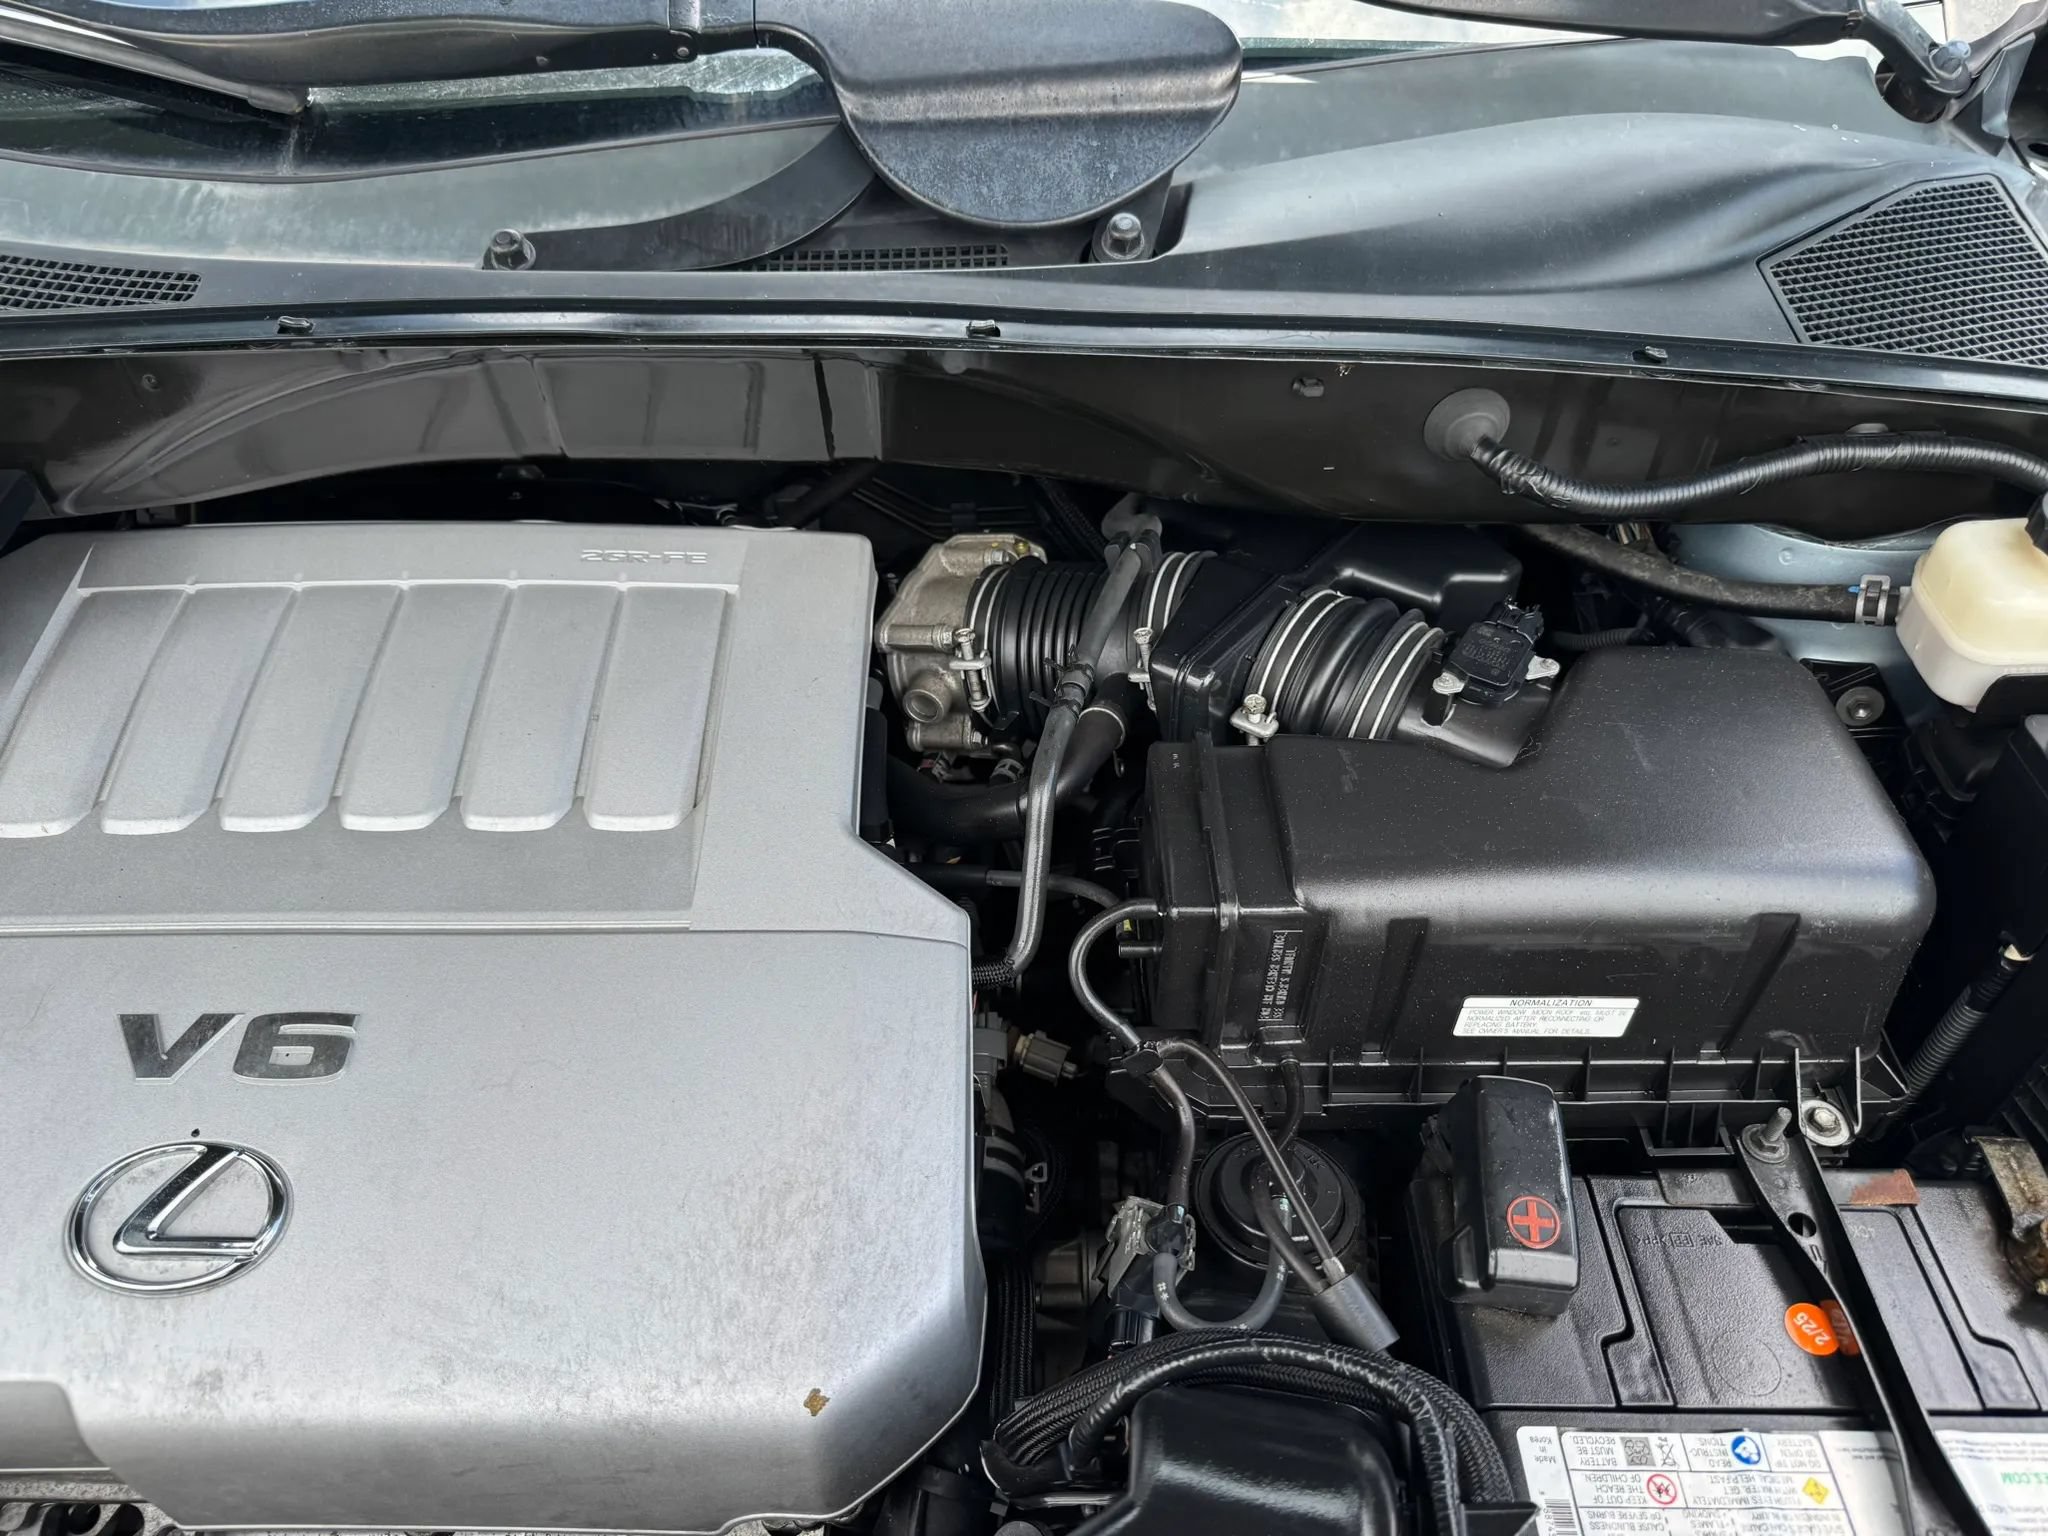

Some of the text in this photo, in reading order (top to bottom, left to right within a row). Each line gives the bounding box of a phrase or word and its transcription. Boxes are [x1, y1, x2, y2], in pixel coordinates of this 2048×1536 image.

[581, 549, 708, 564] 2GR-FE
[115, 1012, 361, 1086] V6
[1793, 1311, 1831, 1346] 2/25
[1529, 1436, 1552, 1445] Korea
[1569, 1436, 1616, 1445] RECYCLED.
[1577, 1446, 1588, 1454] BE
[1534, 1456, 1556, 1464] Made
[1580, 1457, 1617, 1466] BATTERY
[1628, 1474, 1641, 1483] OF
[1595, 1485, 1644, 1494] THE REACH
[1723, 1486, 1740, 1495] GET
[1593, 1495, 1647, 1504] KEEP OUT OF
[1618, 1512, 1648, 1520] SEVERE
[1589, 1522, 1664, 1531] CAUSE BLINDNESS
